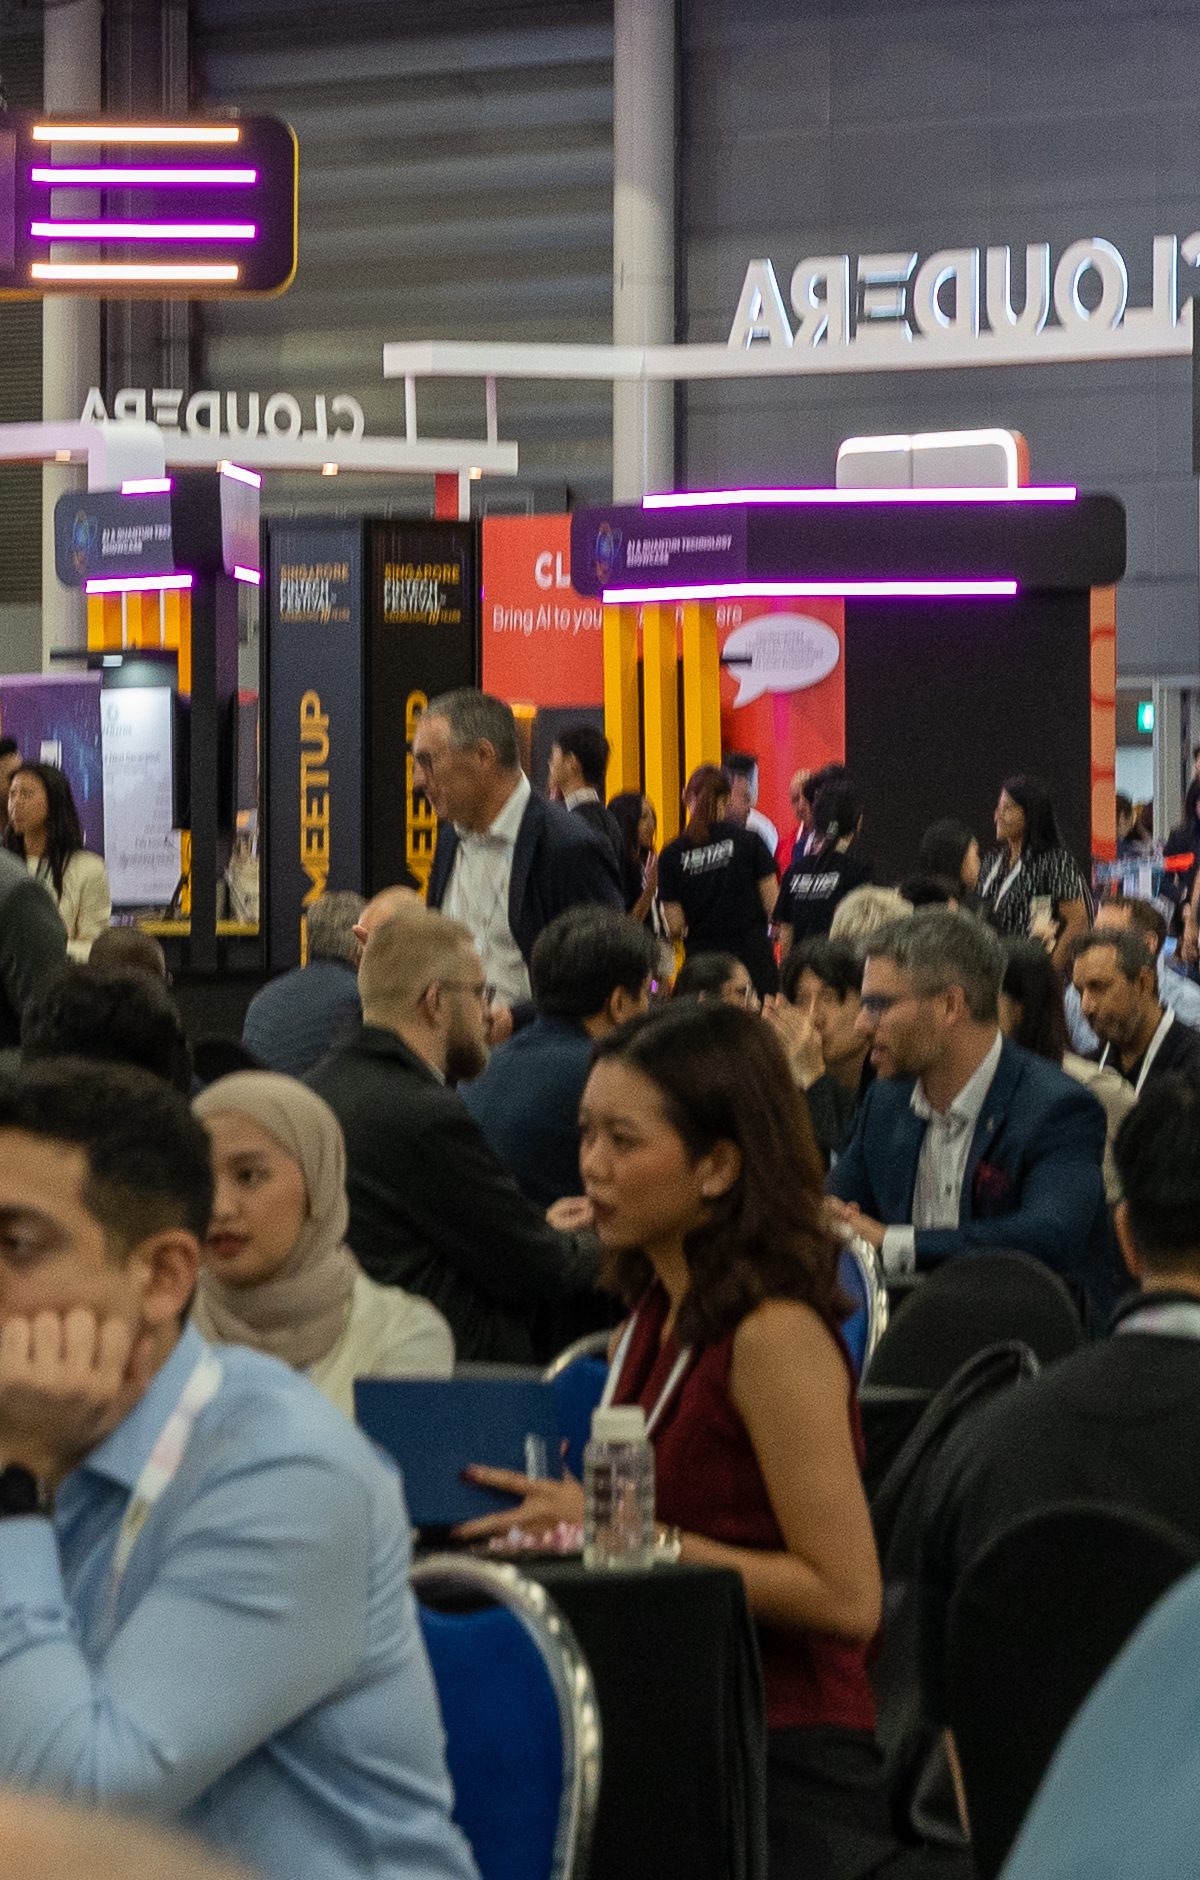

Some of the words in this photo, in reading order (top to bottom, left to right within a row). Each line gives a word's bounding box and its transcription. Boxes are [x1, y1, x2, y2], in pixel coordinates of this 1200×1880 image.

[493, 605, 533, 637] Bring
[537, 606, 551, 631] AI
[555, 606, 570, 631] to
[300, 689, 330, 908] MEETUP
